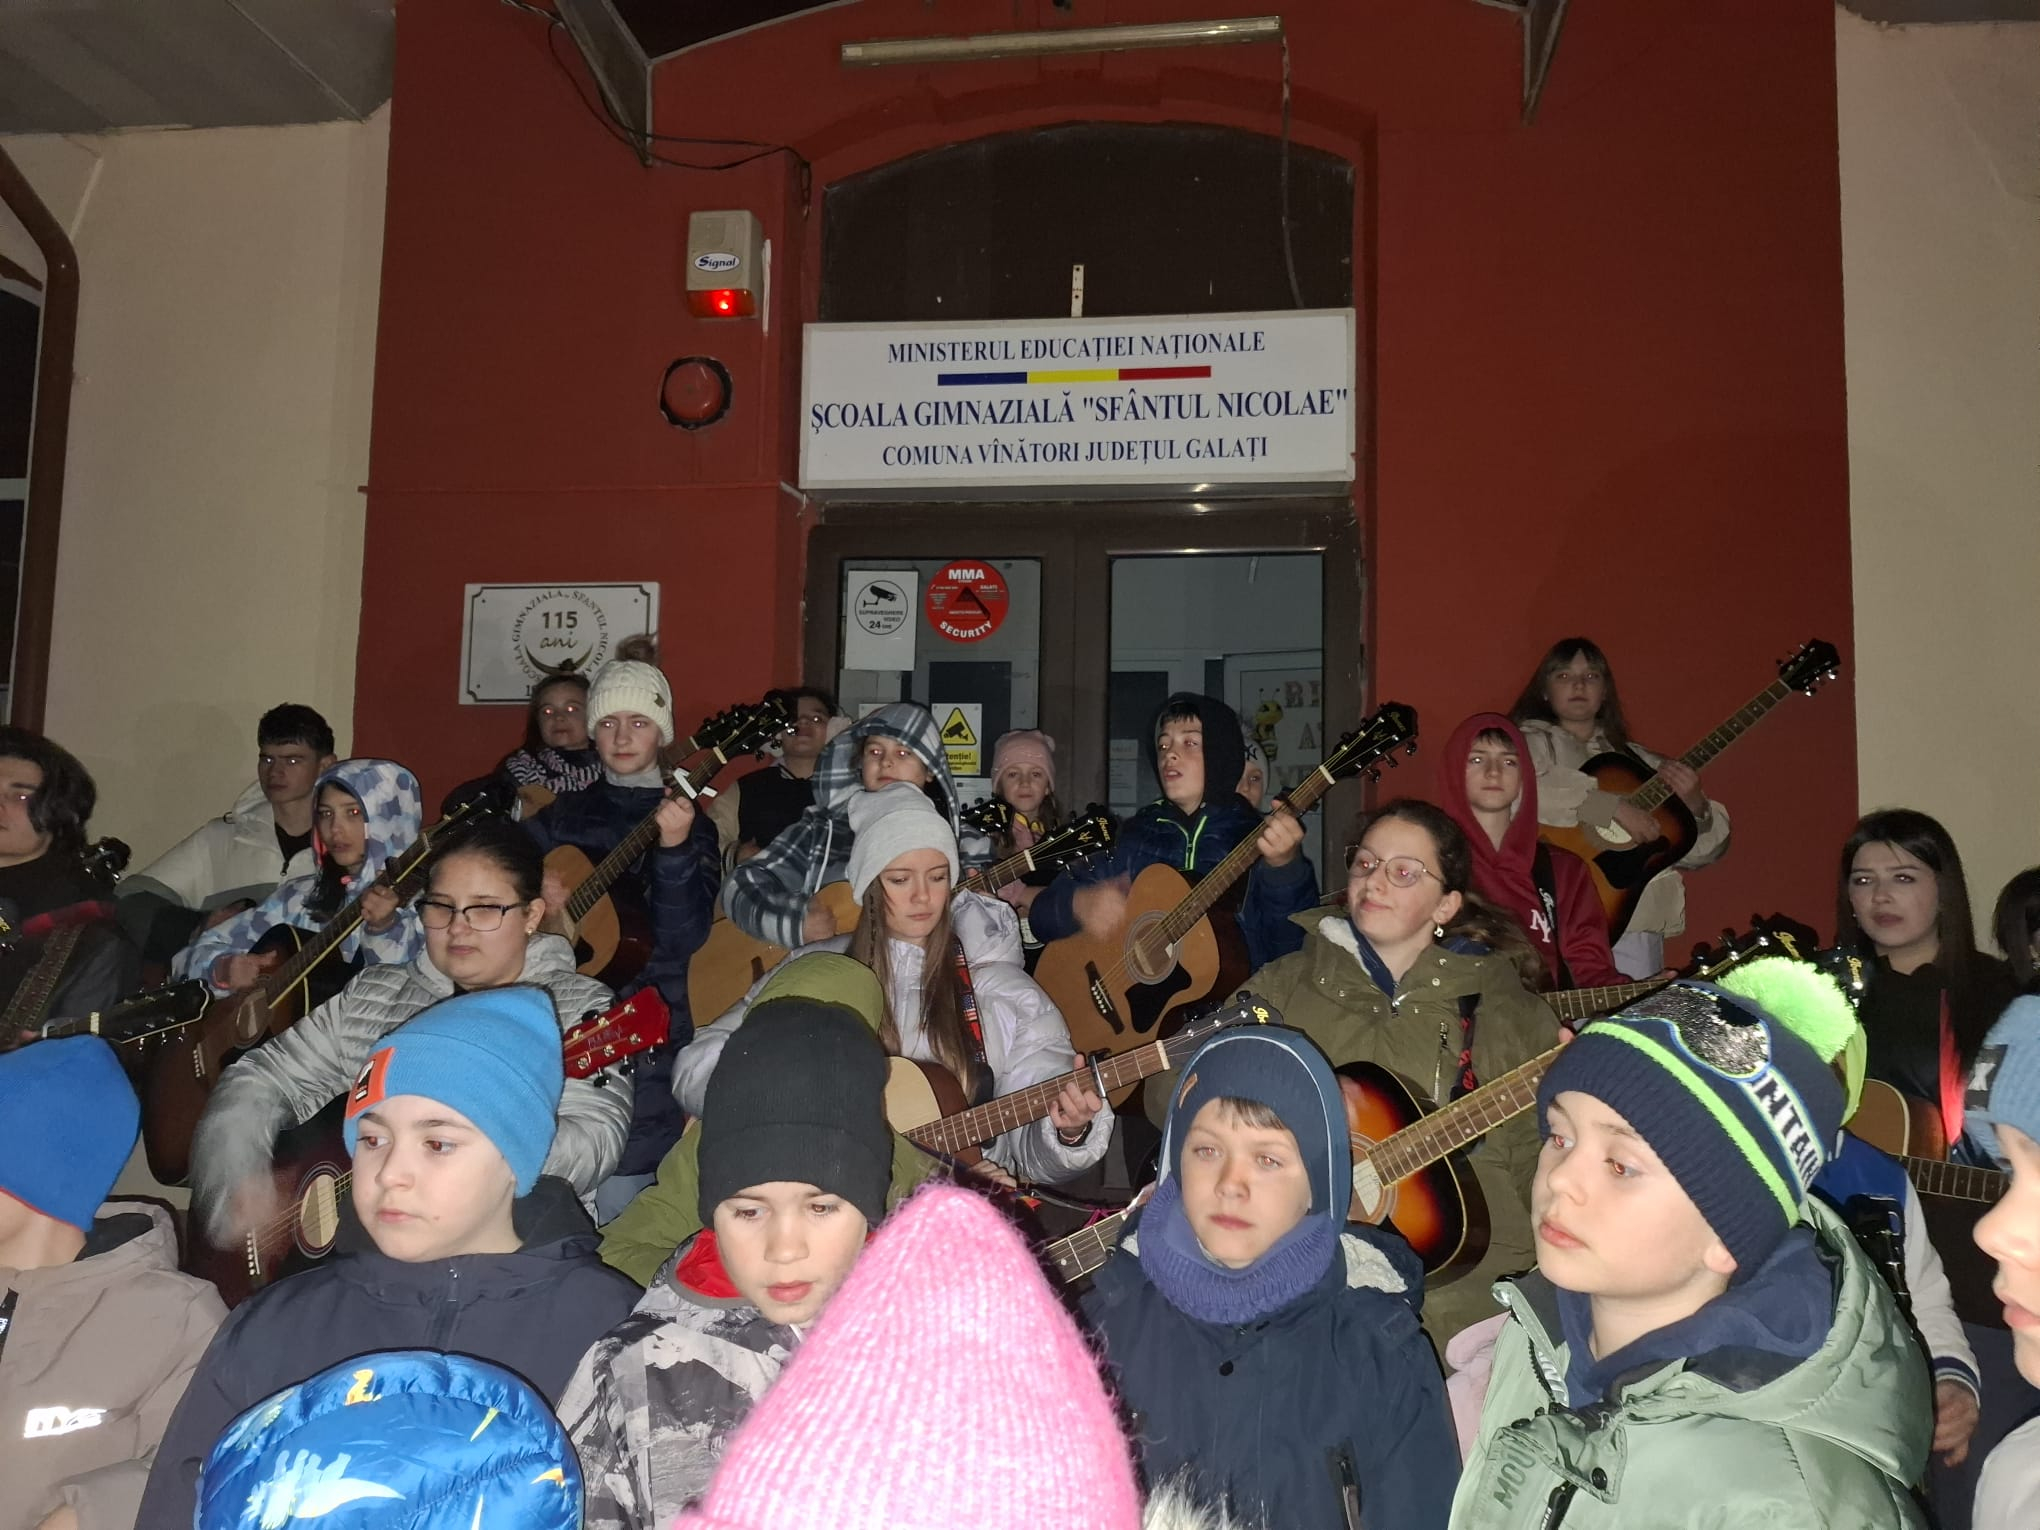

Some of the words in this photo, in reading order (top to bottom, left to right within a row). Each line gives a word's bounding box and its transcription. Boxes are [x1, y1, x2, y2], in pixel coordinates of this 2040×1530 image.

[699, 256, 736, 269] Signal
[888, 340, 1015, 363] MINISTERUL
[1021, 336, 1133, 362] EDUCAȚIEI
[1141, 331, 1265, 359] NAȚIONALE
[915, 390, 1075, 426] GIMNAZIALĂ
[1217, 388, 1348, 418] NICOLAE"
[883, 444, 973, 466] COMUNA
[977, 438, 1078, 464] VÎNĂTORI
[1085, 438, 1181, 465] JUDEȚUL
[1186, 436, 1268, 463] GALAȚI
[948, 569, 985, 580] MMA
[541, 611, 578, 629] 115
[869, 620, 881, 629] 24
[939, 620, 993, 639] SECURITY
[539, 631, 580, 649] ani
